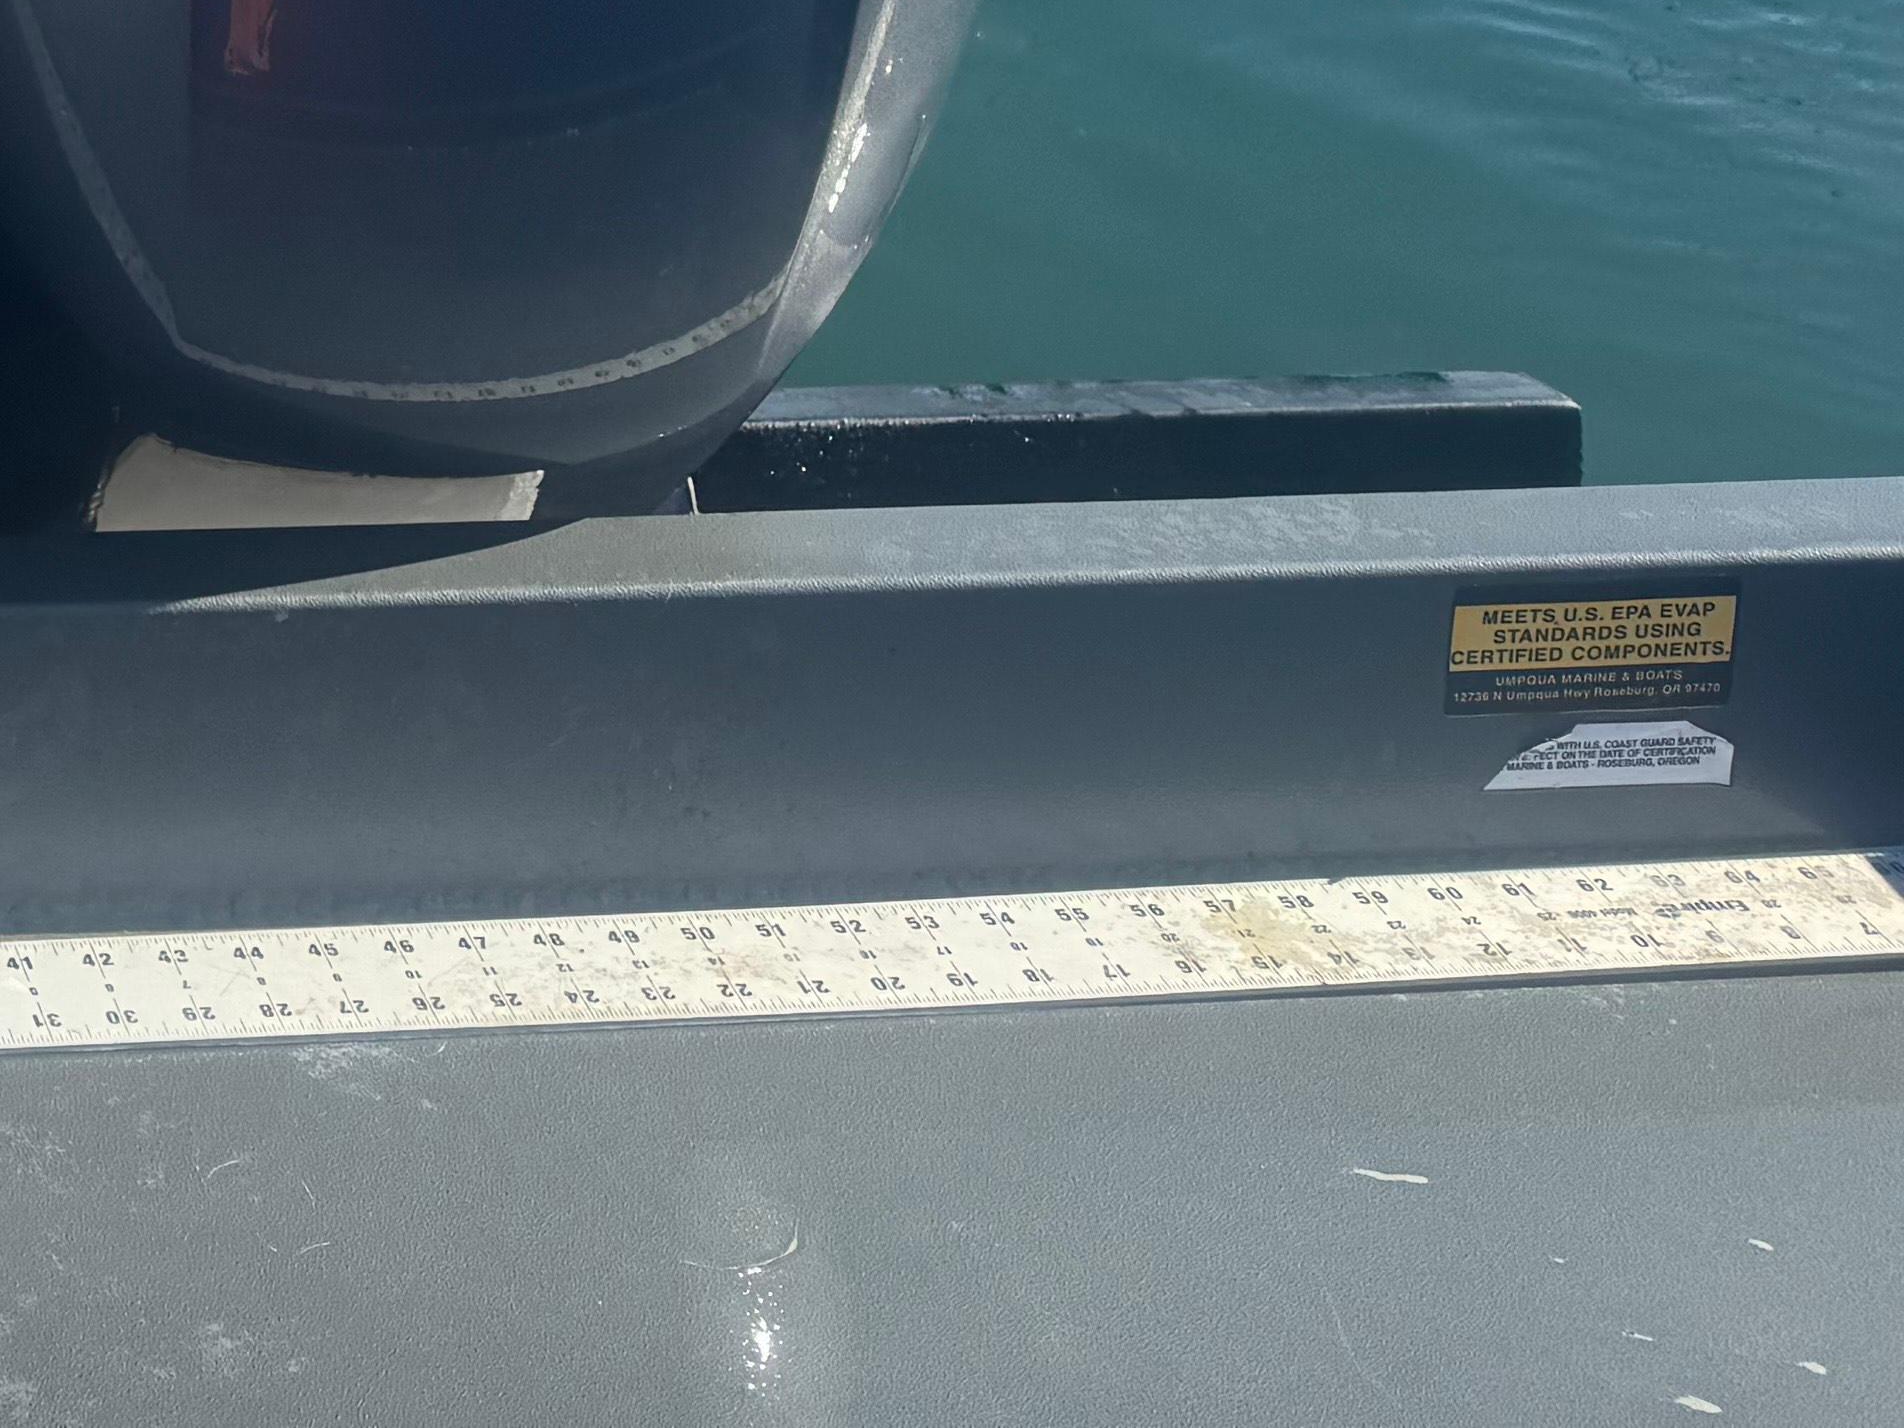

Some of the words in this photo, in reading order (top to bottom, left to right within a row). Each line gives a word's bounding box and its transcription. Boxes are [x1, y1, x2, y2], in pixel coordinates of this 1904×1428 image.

[1482, 607, 1555, 625] MEETS
[1564, 606, 1604, 622] U.S.
[1612, 604, 1652, 621] EPA
[1660, 601, 1716, 618] EVAP
[1493, 625, 1626, 644] STANDARDS
[1635, 622, 1702, 639] USING
[1451, 646, 1563, 665] CERTIFIED
[1571, 640, 1731, 661] COMPONENTS.
[1495, 675, 1556, 687] UMPQUA
[1562, 672, 1617, 685] MARINE
[1622, 671, 1630, 682] &
[1635, 669, 1683, 681] BOATS
[1493, 691, 1502, 701] N
[1506, 690, 1559, 702] Umpqua
[1563, 688, 1591, 700] Hwy
[1662, 684, 1681, 695] OR
[1557, 741, 1581, 750] WITH
[1583, 740, 1601, 749] U.S.
[1604, 739, 1638, 748] COAST
[1639, 737, 1675, 747] GUARD
[1677, 736, 1716, 746] SAFETY
[1561, 750, 1576, 760] ON
[1578, 750, 1596, 759] THE
[1599, 749, 1625, 758] DATE
[1627, 748, 1641, 757] OF
[1642, 746, 1716, 757] CERTIFICATION
[1547, 761, 1554, 770] &
[1556, 760, 1589, 769] BOATS
[1597, 757, 1655, 768] ROSEBURG,
[1657, 756, 1700, 766] OREGON
[7, 956, 33, 971] 41
[82, 953, 114, 968] 42
[159, 949, 189, 964] 43
[234, 947, 264, 961] 44
[309, 943, 339, 957] 45
[383, 940, 414, 954] 46
[458, 937, 487, 951] 47
[533, 933, 564, 947] 48
[608, 929, 640, 944] 49
[680, 926, 715, 941] 50
[755, 923, 786, 938] 51
[830, 919, 866, 934] 52
[906, 916, 940, 931] 53
[980, 912, 1014, 927] 54
[1055, 907, 1089, 921] 55
[1130, 904, 1164, 918] 56
[1204, 900, 1237, 914] 57
[1278, 897, 1314, 911] 58
[1352, 894, 1389, 908] 59
[1427, 890, 1463, 904] 60
[1502, 883, 1534, 896] 61
[1576, 880, 1613, 893] 62
[717, 982, 753, 998] 22
[870, 975, 906, 991] 20
[489, 992, 522, 1007] 25
[564, 989, 600, 1004] 24
[641, 986, 676, 1002] 23
[259, 1003, 292, 1018] 28
[412, 996, 445, 1011] 26
[106, 1009, 138, 1025] 30
[182, 1006, 216, 1021] 29
